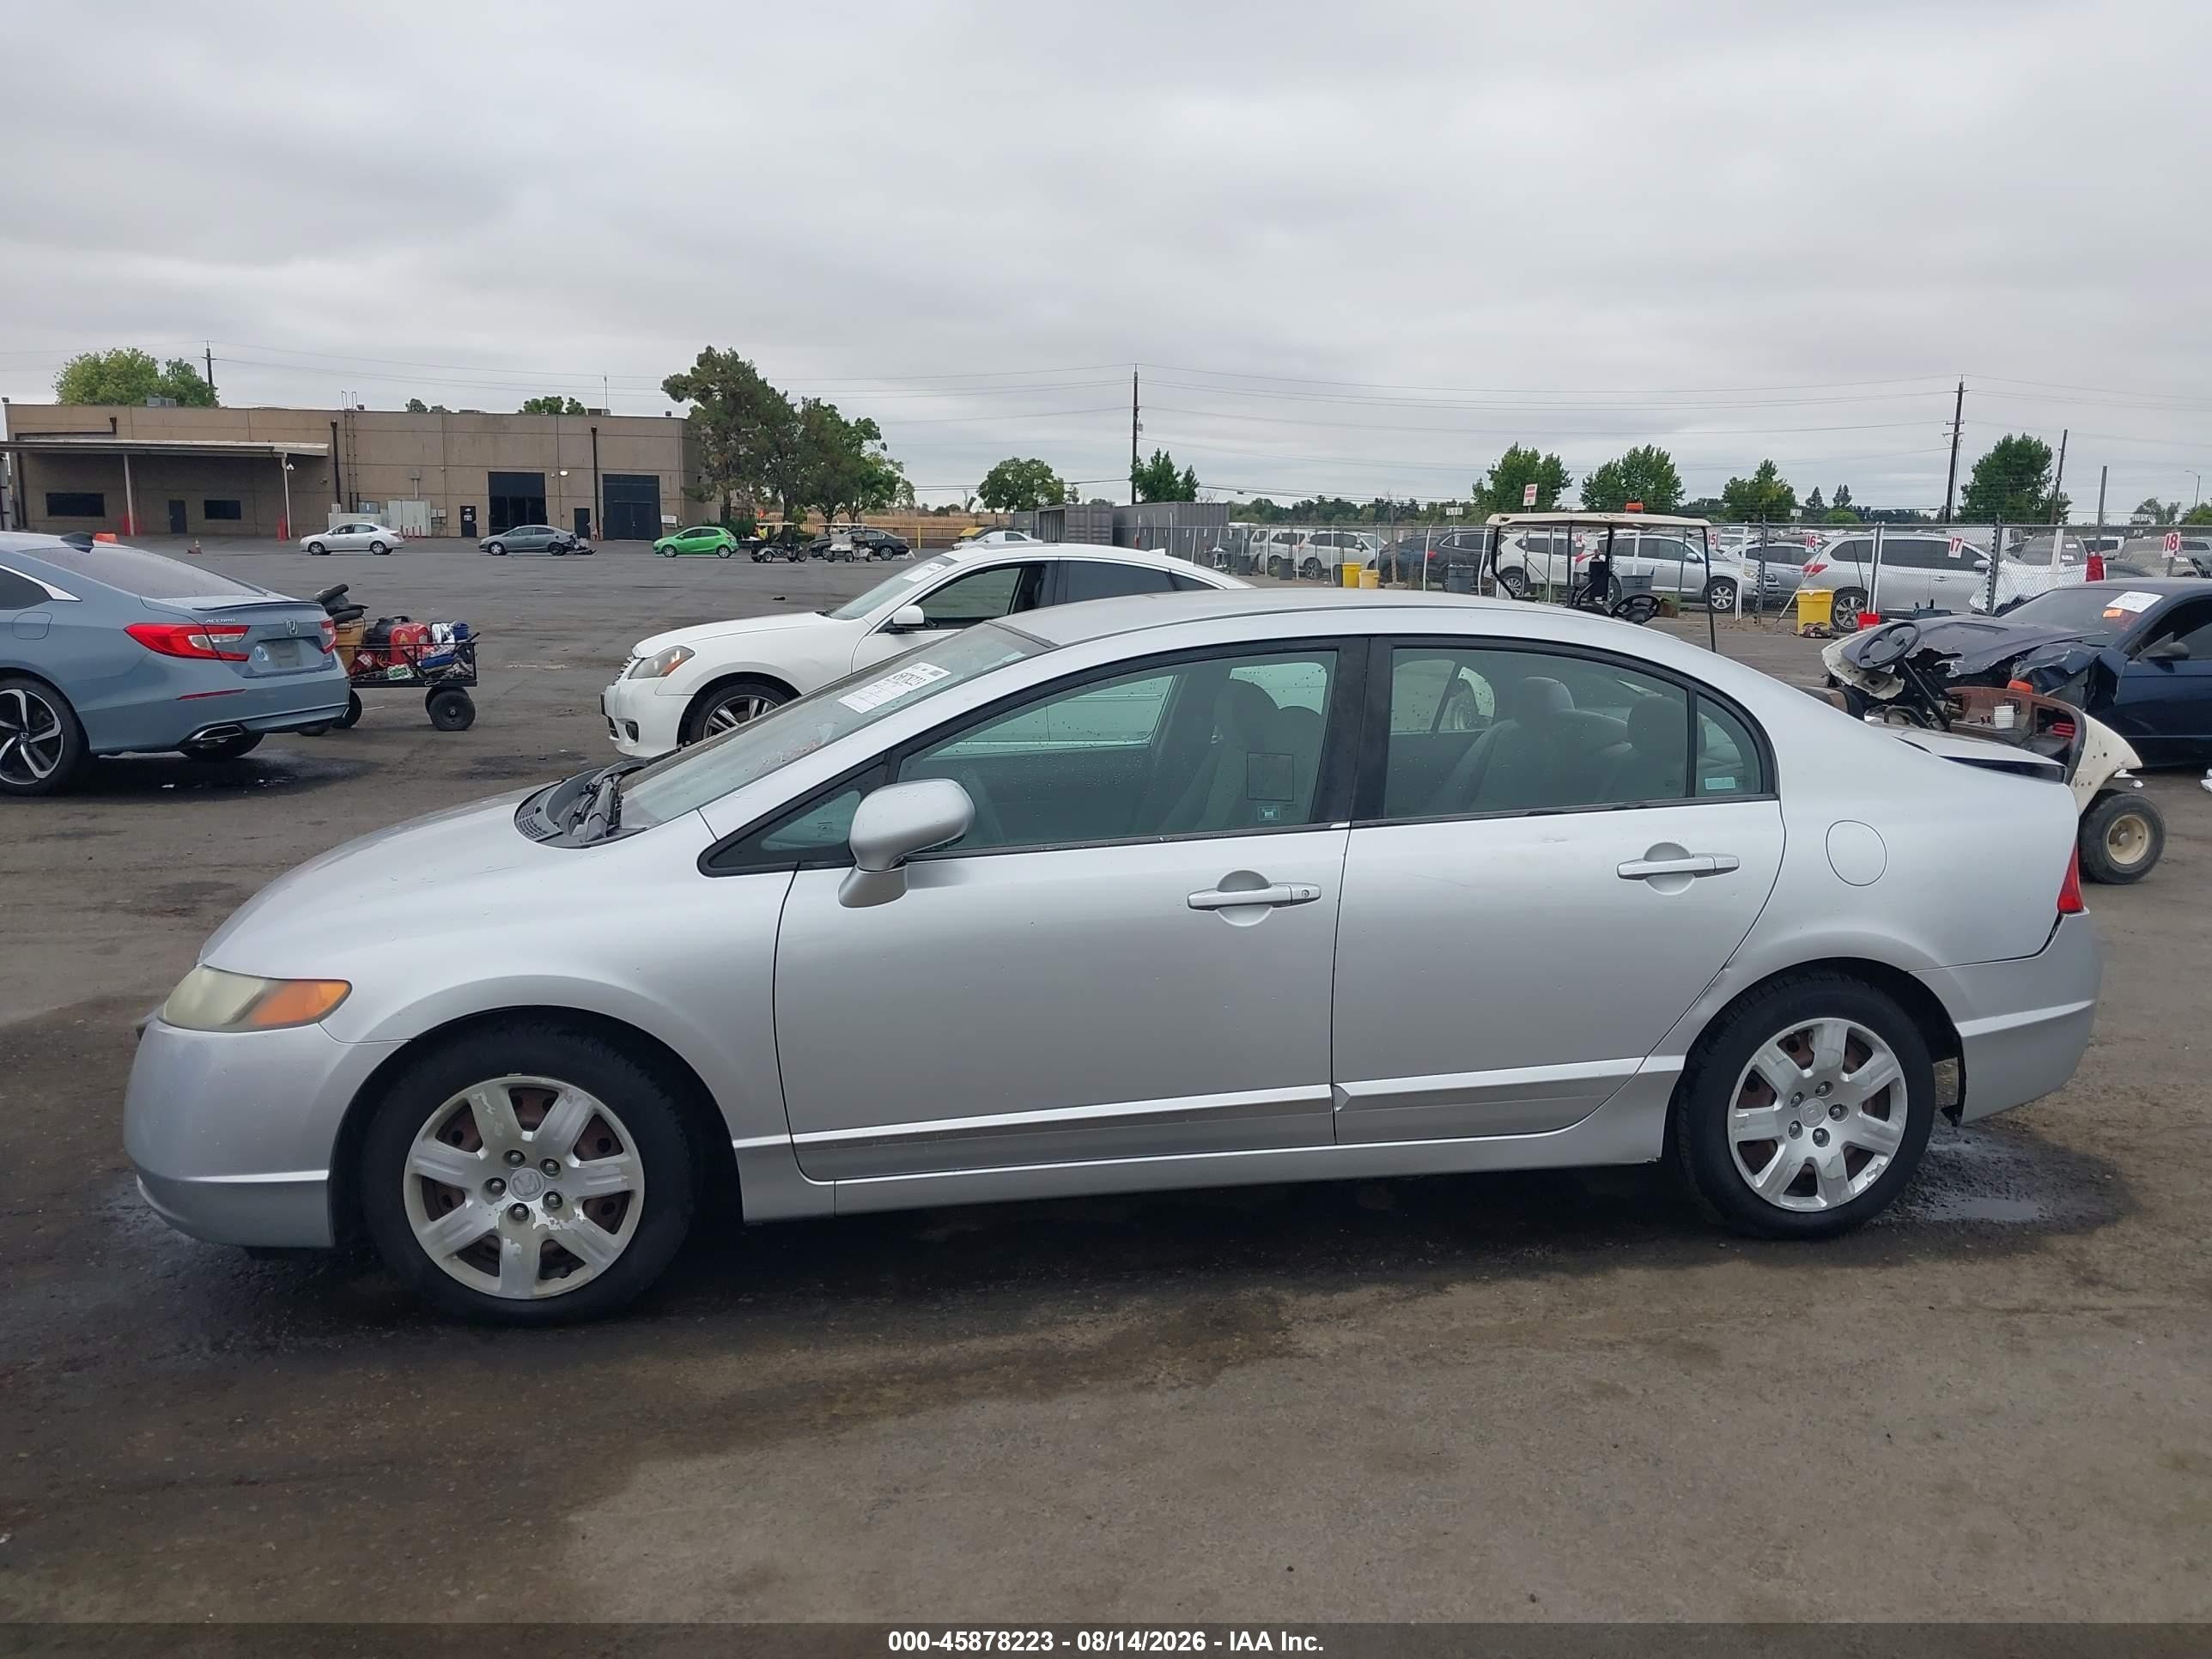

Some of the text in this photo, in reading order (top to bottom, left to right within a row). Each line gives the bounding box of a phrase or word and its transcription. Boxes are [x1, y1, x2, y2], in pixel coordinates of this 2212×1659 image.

[1575, 533, 1583, 544] 14
[1708, 533, 1717, 545] 15
[1806, 535, 1817, 548] 16
[1950, 537, 1963, 552] 17
[2164, 533, 2179, 552] 18
